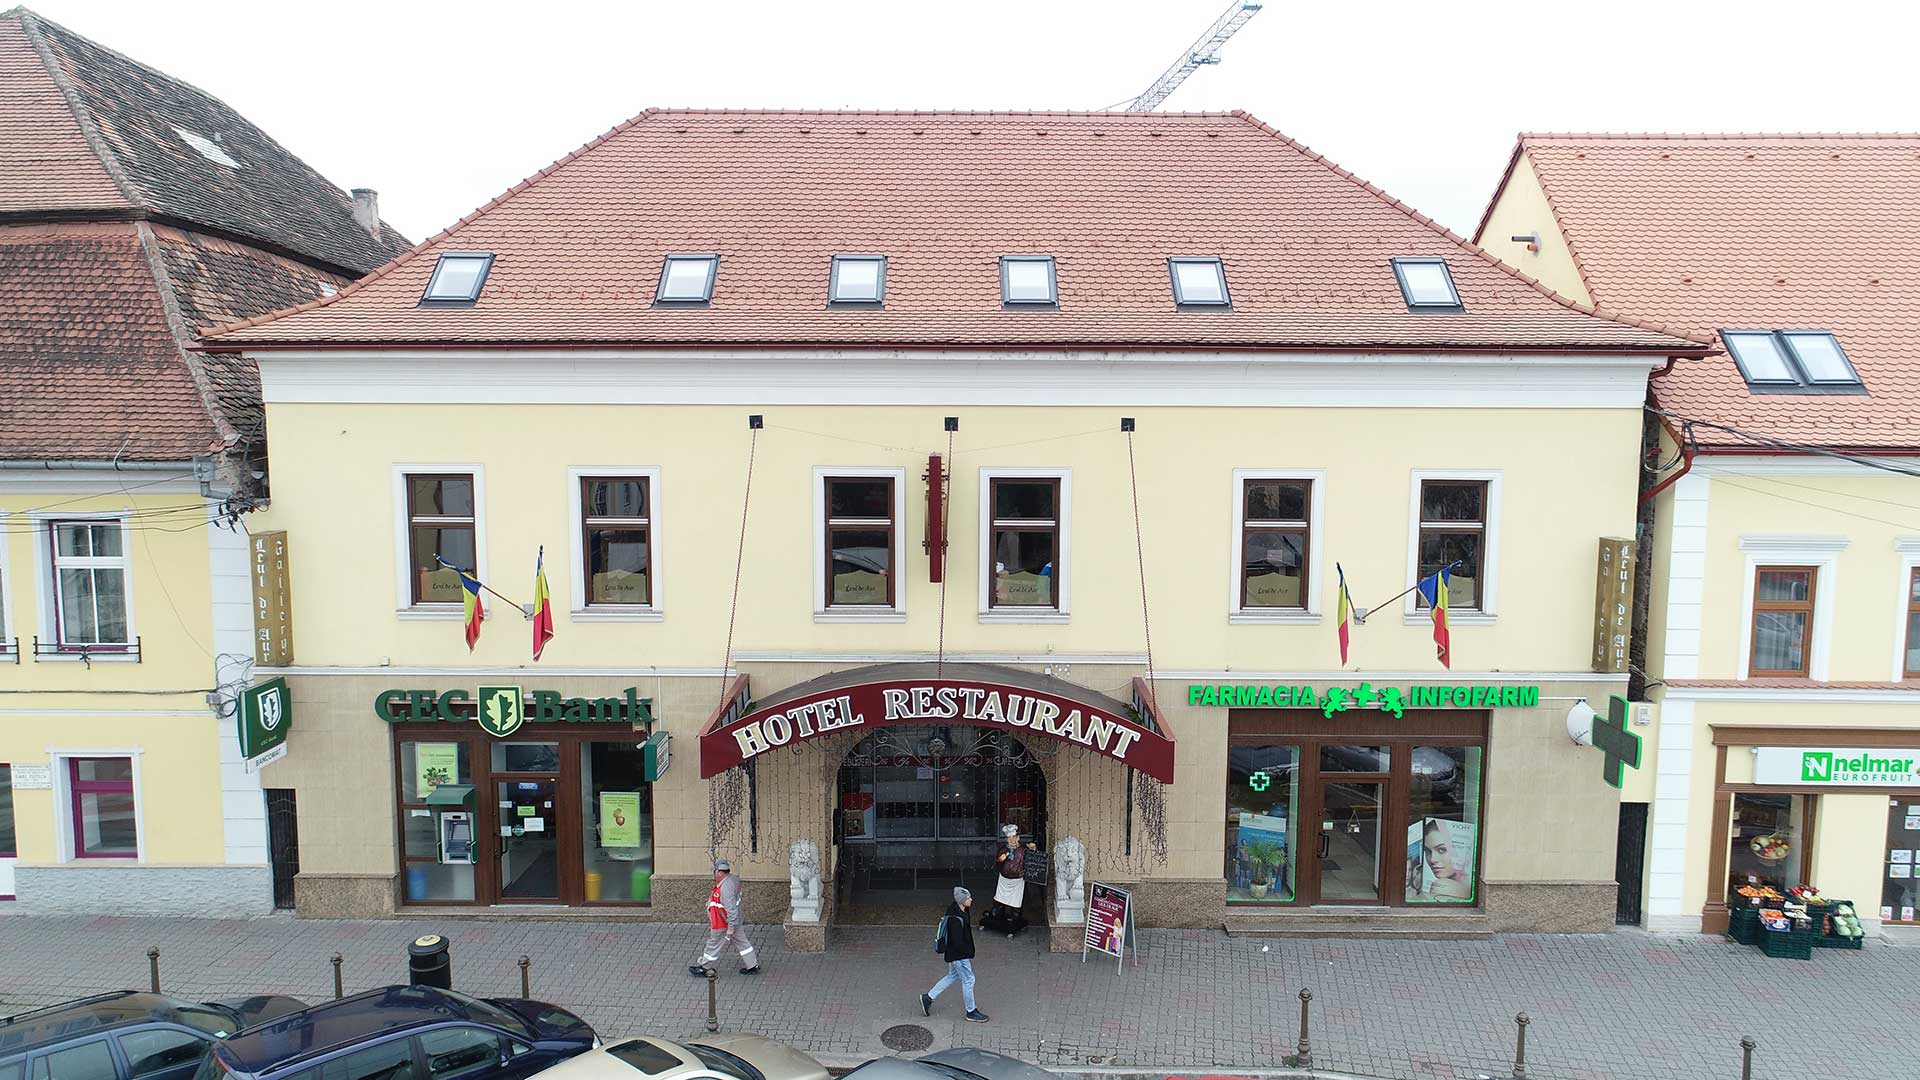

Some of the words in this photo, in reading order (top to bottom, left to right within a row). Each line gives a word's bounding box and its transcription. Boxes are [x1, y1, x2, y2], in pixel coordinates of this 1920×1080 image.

[255, 538, 266, 588] Leul
[1620, 544, 1630, 594] Leul
[258, 627, 271, 663] Aur
[1614, 634, 1625, 669] Aur
[374, 688, 470, 724] CEC
[531, 687, 658, 724] Bank
[1188, 685, 1317, 707] FARMACIA
[1410, 684, 1540, 708] INFOFARM
[732, 695, 866, 760] HOTEL
[882, 686, 1141, 760] RESTAURANT
[1833, 753, 1914, 773] nelmar
[1833, 773, 1913, 782] EUROFRUIT
